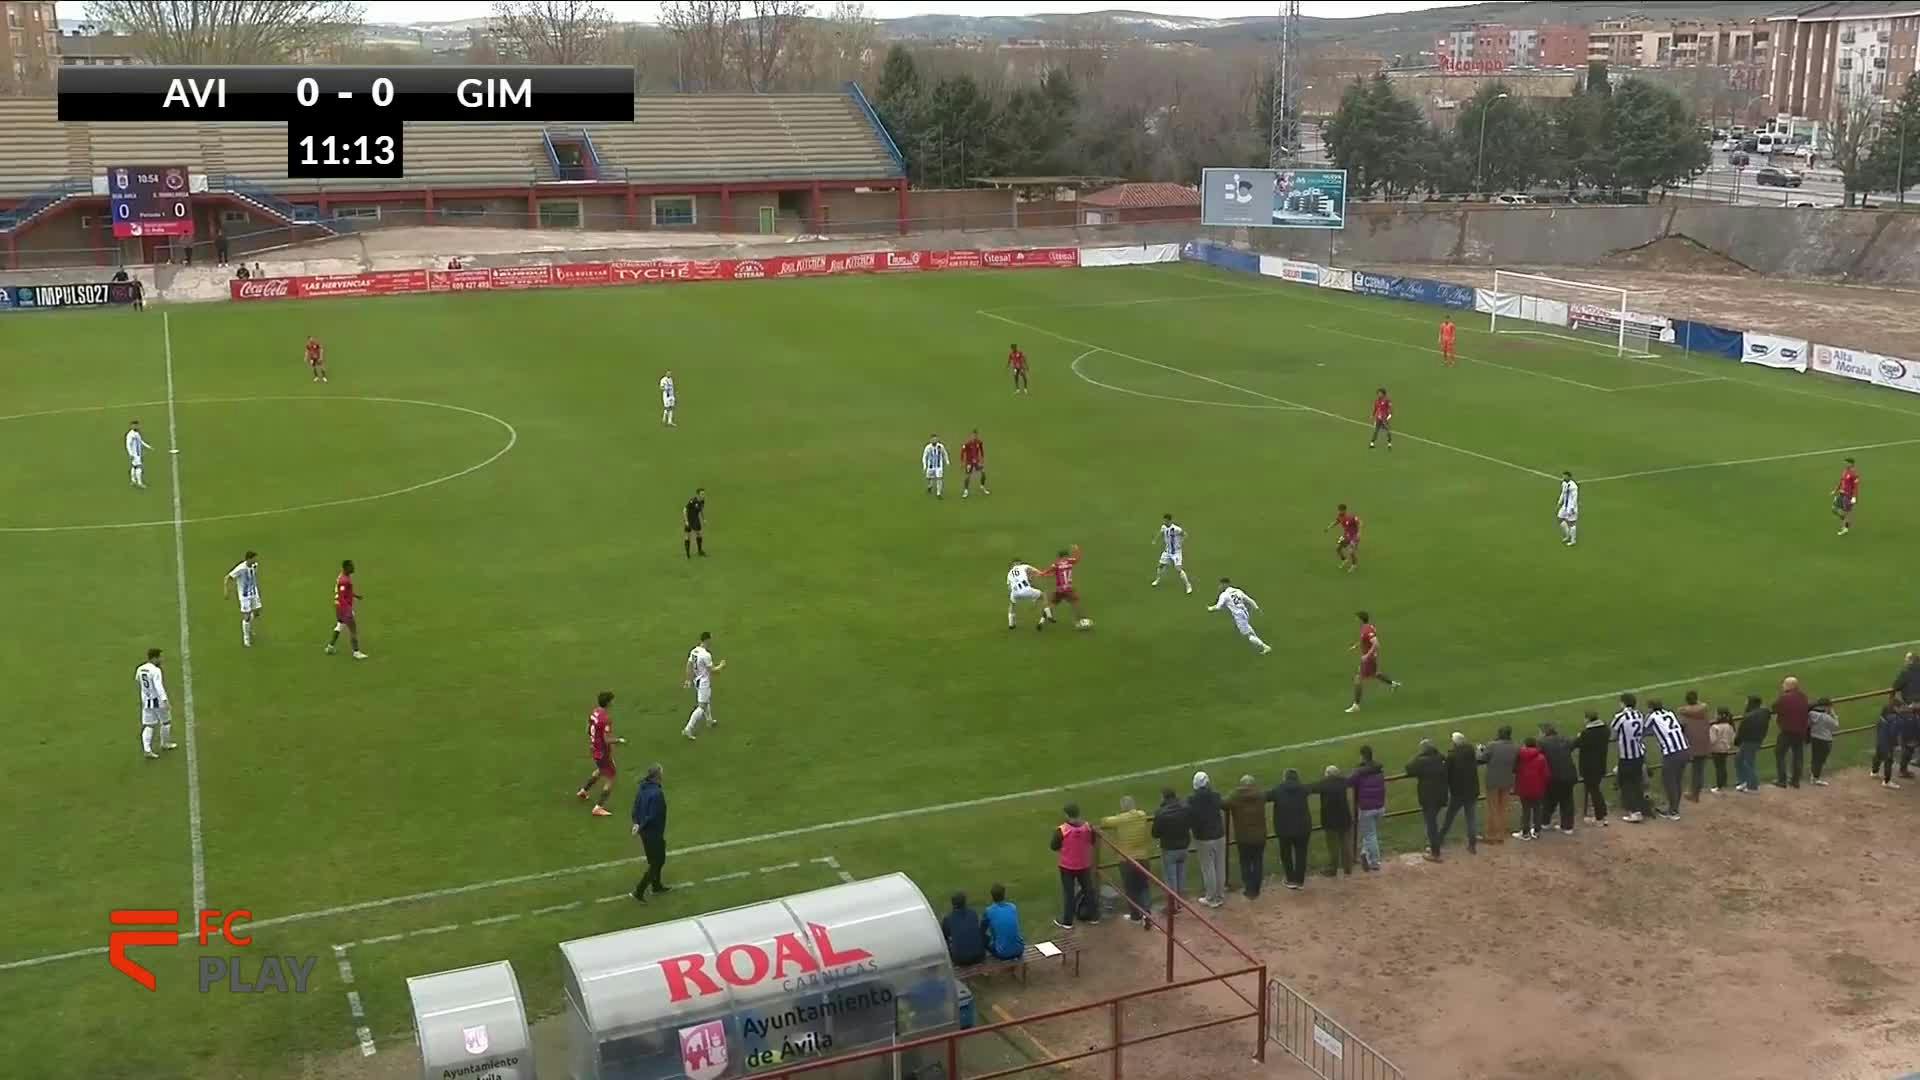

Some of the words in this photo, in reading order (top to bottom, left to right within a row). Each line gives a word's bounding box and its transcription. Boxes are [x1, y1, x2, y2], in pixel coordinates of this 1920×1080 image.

[119, 204, 130, 219] 0
[174, 202, 185, 218] 0
[321, 279, 376, 290] HERVENCIAS"
[36, 284, 109, 306] IMPULSO27
[1833, 349, 1853, 363] Alta
[1836, 360, 1872, 377] Moraña
[142, 674, 149, 688] 5
[657, 921, 873, 1003] ROAL
[782, 959, 880, 993] CARNICAS
[743, 989, 893, 1039] Ayuntamiento
[746, 1050, 774, 1069] de
[781, 1033, 833, 1058] Ávila
[442, 1056, 519, 1080] Ayuntamiento
